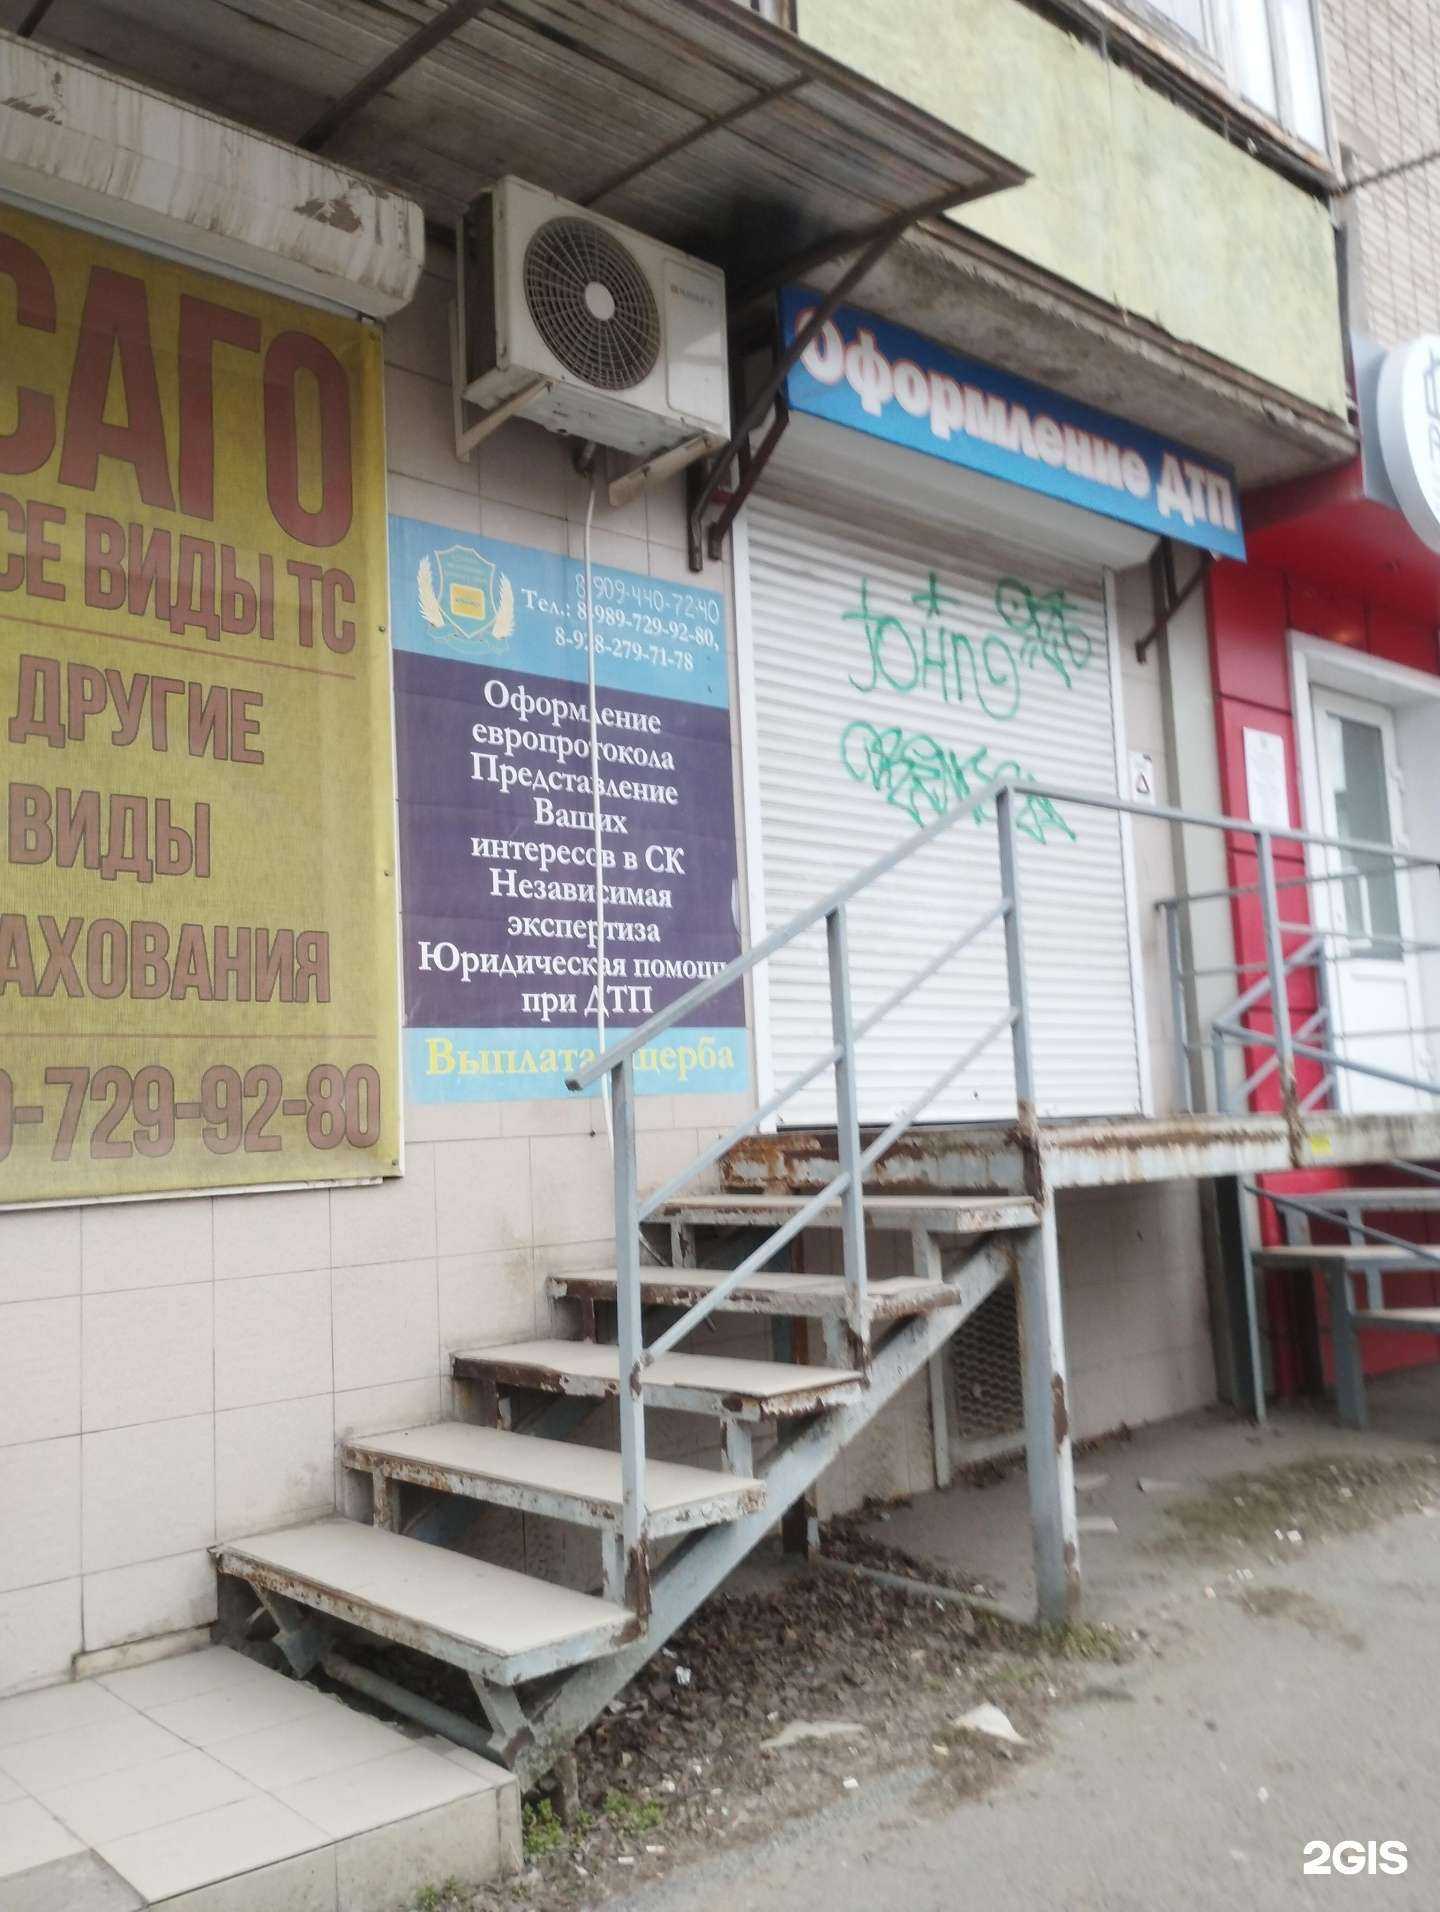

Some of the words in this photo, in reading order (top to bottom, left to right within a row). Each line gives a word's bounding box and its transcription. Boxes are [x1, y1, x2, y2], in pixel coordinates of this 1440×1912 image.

[0, 233, 354, 549] САГО
[795, 308, 1152, 499] Оформление
[1156, 451, 1237, 534] ДТП
[84, 511, 276, 642] ВИДЫ
[287, 559, 356, 655] ТС
[520, 588, 571, 617] Тел.:
[576, 601, 720, 652] 8989-729-92-80,
[8, 654, 265, 765] ДРУГИЕ
[470, 751, 679, 806] Представление
[8, 782, 211, 883] ВИДЫ
[534, 798, 629, 835] Ваших
[489, 867, 673, 909] Независимая
[622, 851, 639, 870] в
[644, 844, 687, 875] СК
[0, 913, 332, 1004] АХОВАНИЯ
[418, 941, 628, 982] Юридическая
[521, 991, 578, 1022] при
[584, 984, 655, 1018] ДТП
[632, 1036, 736, 1081] щерба
